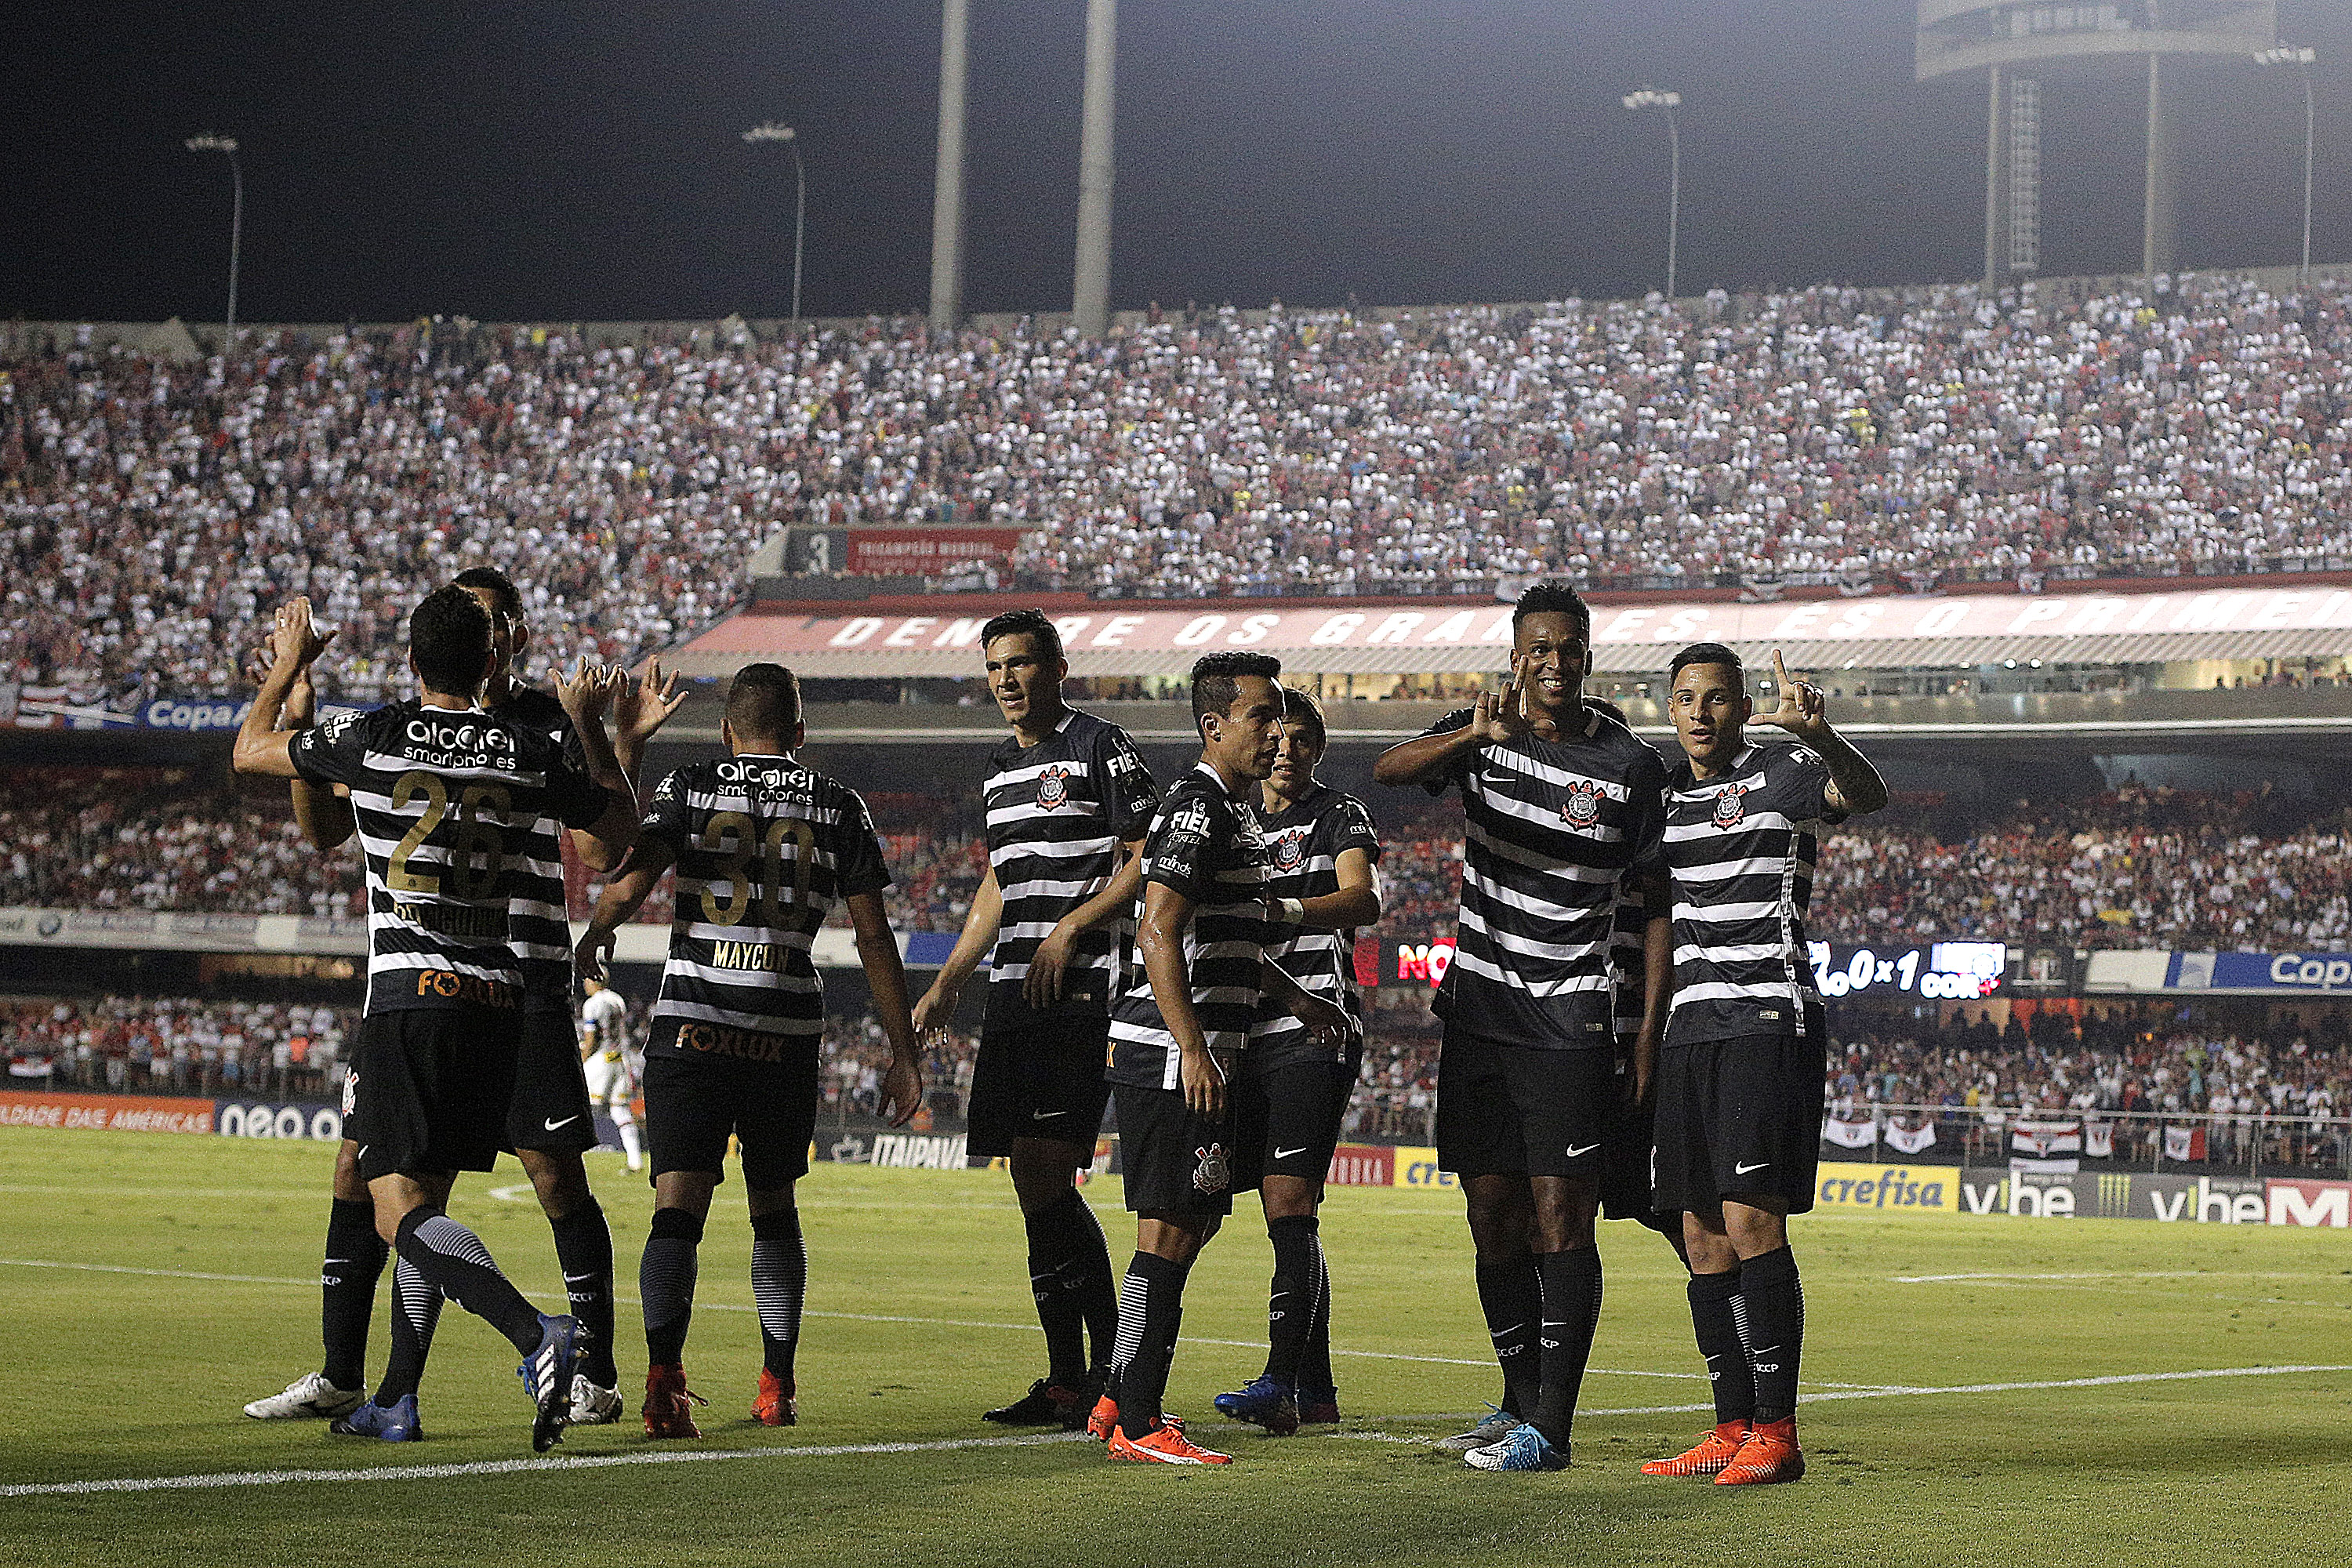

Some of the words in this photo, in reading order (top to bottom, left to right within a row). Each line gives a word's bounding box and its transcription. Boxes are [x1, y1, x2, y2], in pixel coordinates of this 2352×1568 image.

[829, 616, 1143, 648] DENRE
[1174, 615, 1279, 645] OS
[1914, 601, 1971, 634] O
[1171, 811, 1210, 838] FIEL
[701, 811, 814, 928] 30
[712, 940, 789, 972] MAYCON
[2271, 954, 2352, 989] Cop
[221, 1105, 304, 1139] neo
[871, 1133, 968, 1170] ITAIPAVA
[1820, 1170, 1944, 1208] crefisa
